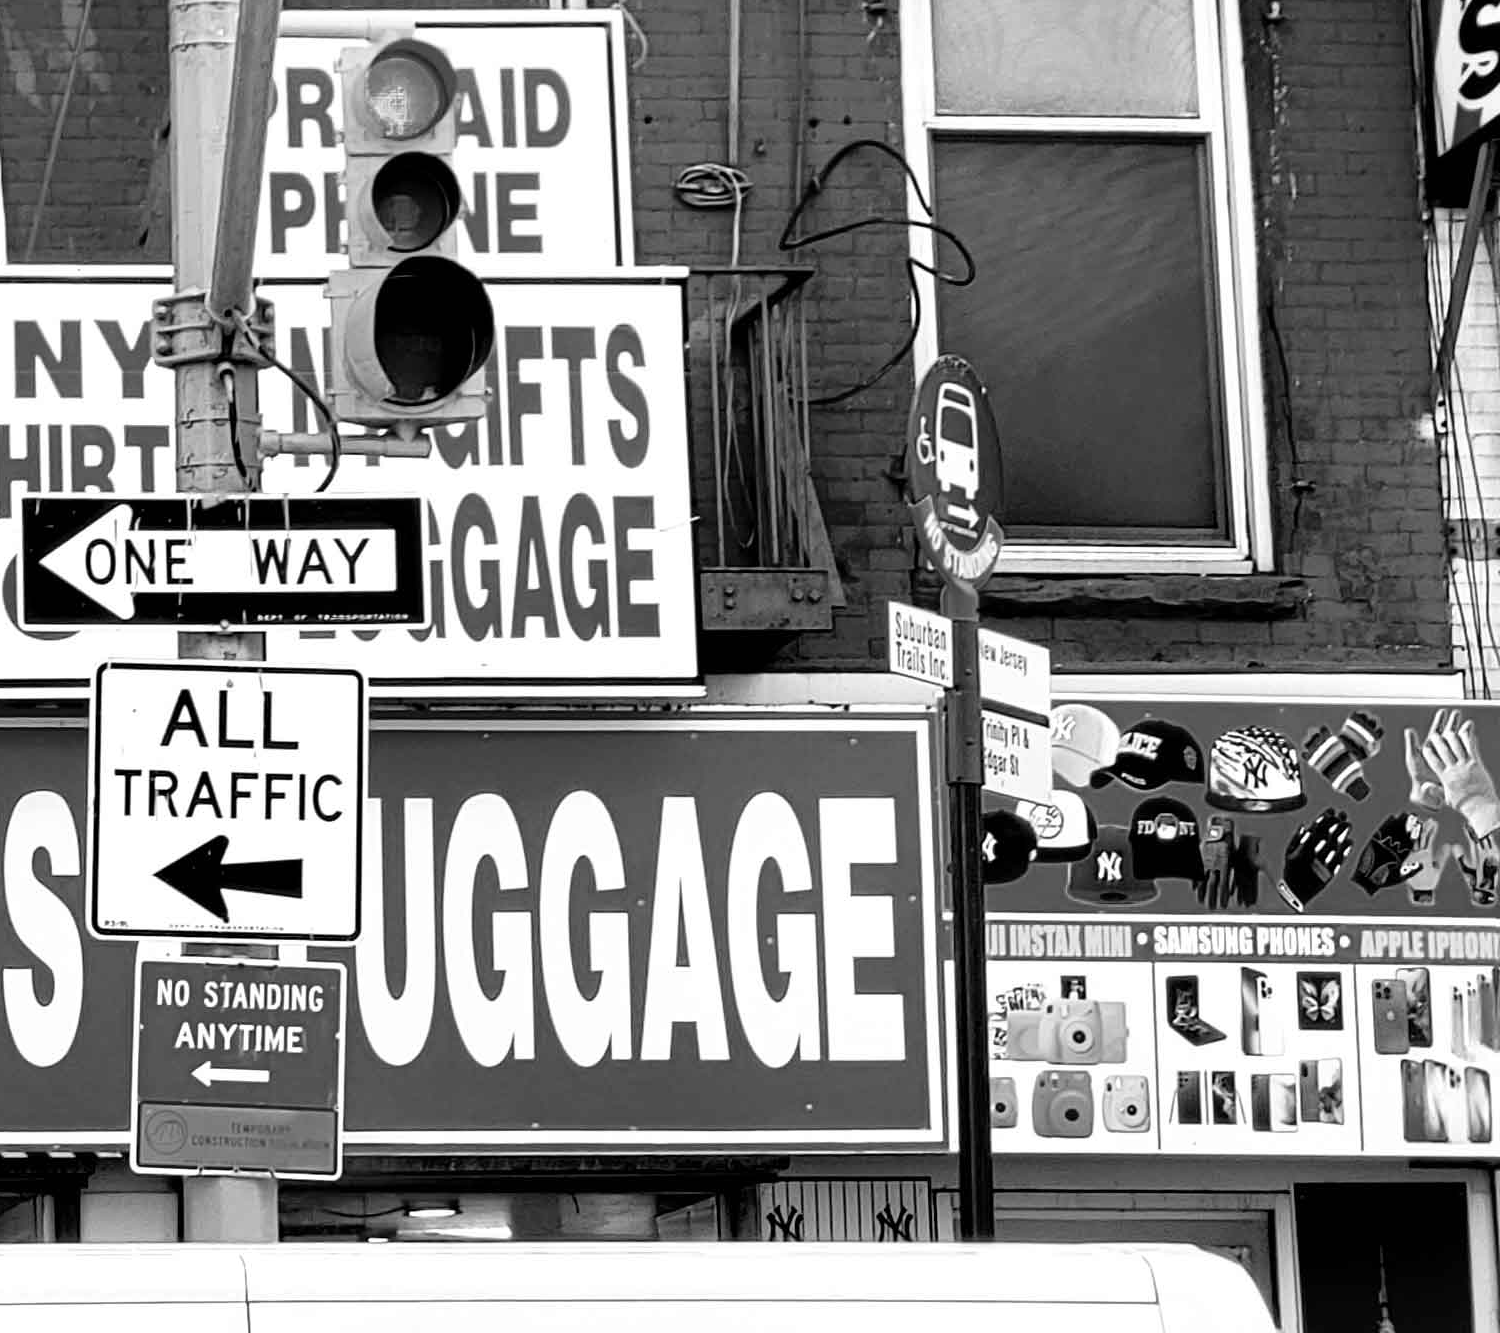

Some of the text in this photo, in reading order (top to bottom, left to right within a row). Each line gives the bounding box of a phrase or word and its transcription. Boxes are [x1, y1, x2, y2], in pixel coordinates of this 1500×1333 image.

[13, 319, 153, 399] NY
[84, 538, 370, 585] ONE WAY
[895, 611, 947, 650] Suburban
[896, 641, 950, 681] Trails Inc.
[160, 688, 300, 750] ALL
[114, 768, 344, 822] TRAFFIC
[356, 790, 906, 1069] UGGAGE
[1009, 924, 1082, 958] INSTAX
[1084, 924, 1133, 958] MINI
[1154, 925, 1253, 956] SAMSUNG
[1257, 927, 1336, 957] PHONES
[1360, 930, 1425, 958] APPLE
[156, 979, 324, 1012] NO STANDING
[174, 1021, 304, 1053] ANYTIME
